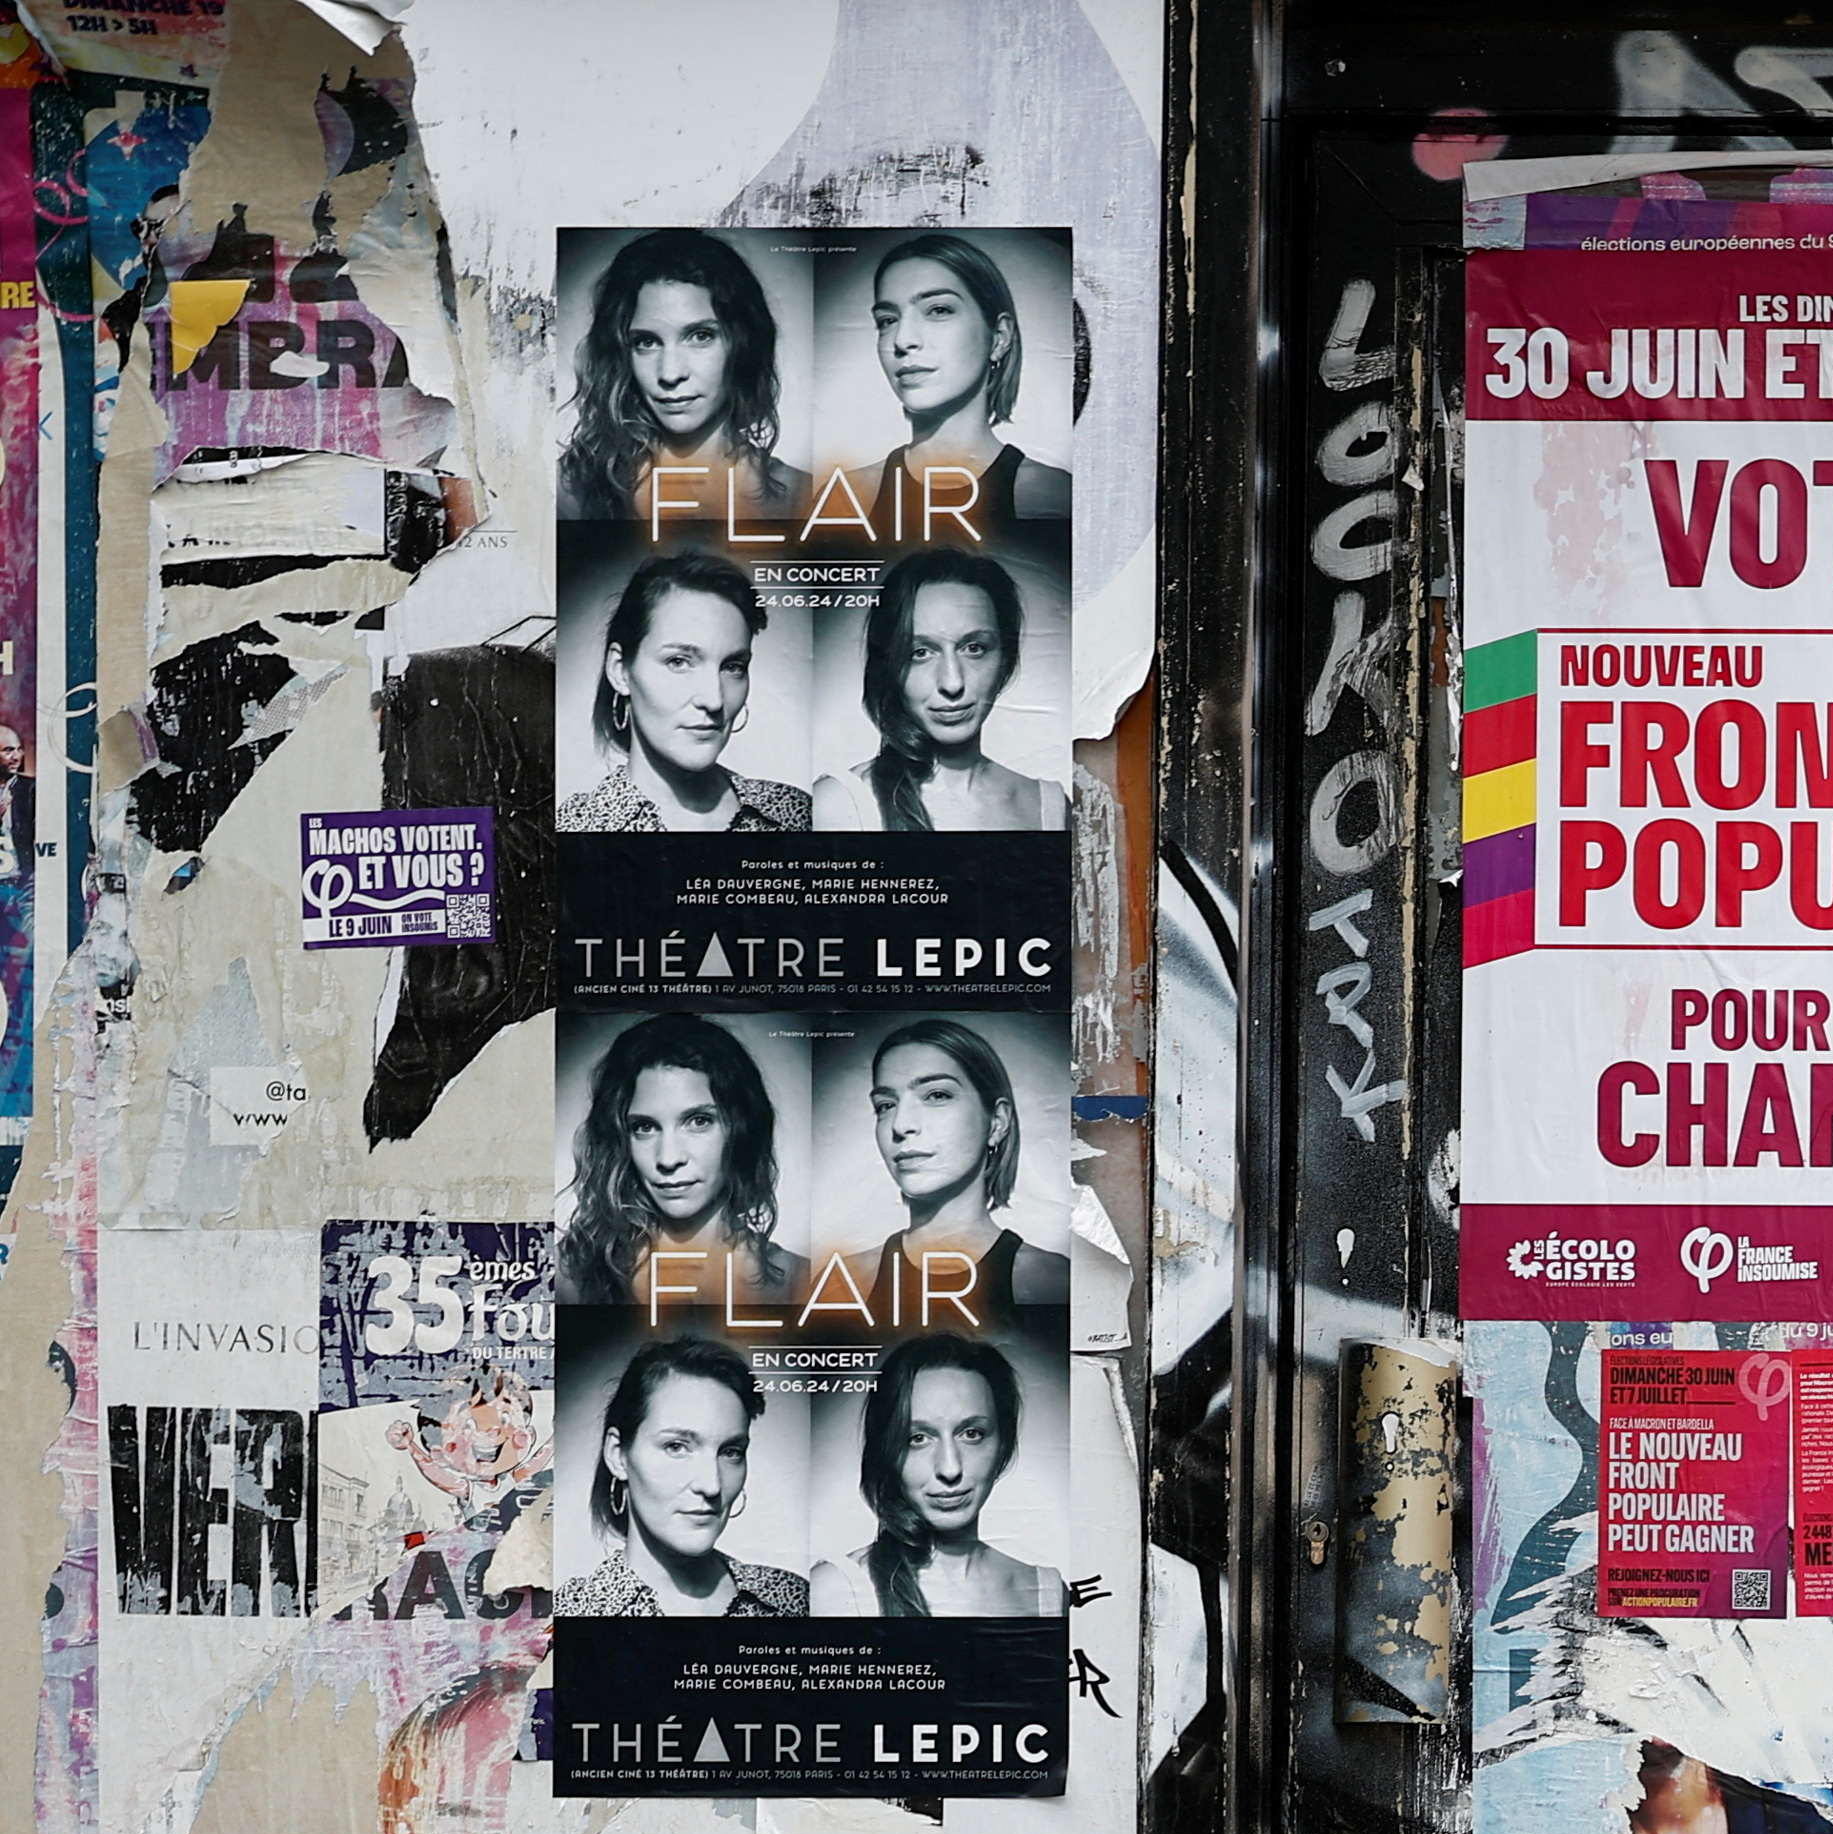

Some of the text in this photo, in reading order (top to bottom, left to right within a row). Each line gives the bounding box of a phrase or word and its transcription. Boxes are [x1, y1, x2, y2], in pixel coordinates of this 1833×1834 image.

[1581, 235, 1665, 251] élections
[1671, 236, 1794, 251] européennes
[1799, 232, 1822, 249] du
[1739, 295, 1789, 322] LES
[1485, 328, 1570, 399] 30
[1586, 329, 1746, 399] JUIN
[652, 467, 982, 542] FLAIR
[755, 568, 880, 582] EN CONCERT
[1560, 644, 1763, 688] NOUVEAU
[309, 818, 322, 828] LES
[309, 824, 482, 855] MACHOS VOTENT.
[358, 853, 463, 890] ET VOUS
[687, 878, 939, 891] LÉA DAUVERGNE, MARIE HENNEREZ,
[677, 894, 949, 906] MARIE COMBEAU, ALEXANDRA LACOUR
[329, 916, 392, 937] LE 9 JUIN
[877, 938, 1052, 977] LEPIC
[1671, 988, 1830, 1052] POUR
[1546, 1232, 1635, 1260] ÉCOLO
[1738, 1246, 1793, 1265] FRANCE
[1546, 1260, 1635, 1281] GISTES
[651, 1252, 979, 1327] FLAIR
[366, 1255, 536, 1357] 35 èmes
[472, 1346, 547, 1359] DU TERTRE
[752, 1353, 877, 1367] EN CONCERT
[1610, 1368, 1735, 1385] DIMANCHE 30 JUIN
[1610, 1387, 1686, 1404] ET 7 JUILLET
[1609, 1432, 1742, 1461] LE NOUVEAU
[1609, 1462, 1679, 1490] FRONT
[1609, 1494, 1725, 1521] POPULAIRE
[1608, 1524, 1754, 1553] PEUT GAGNER
